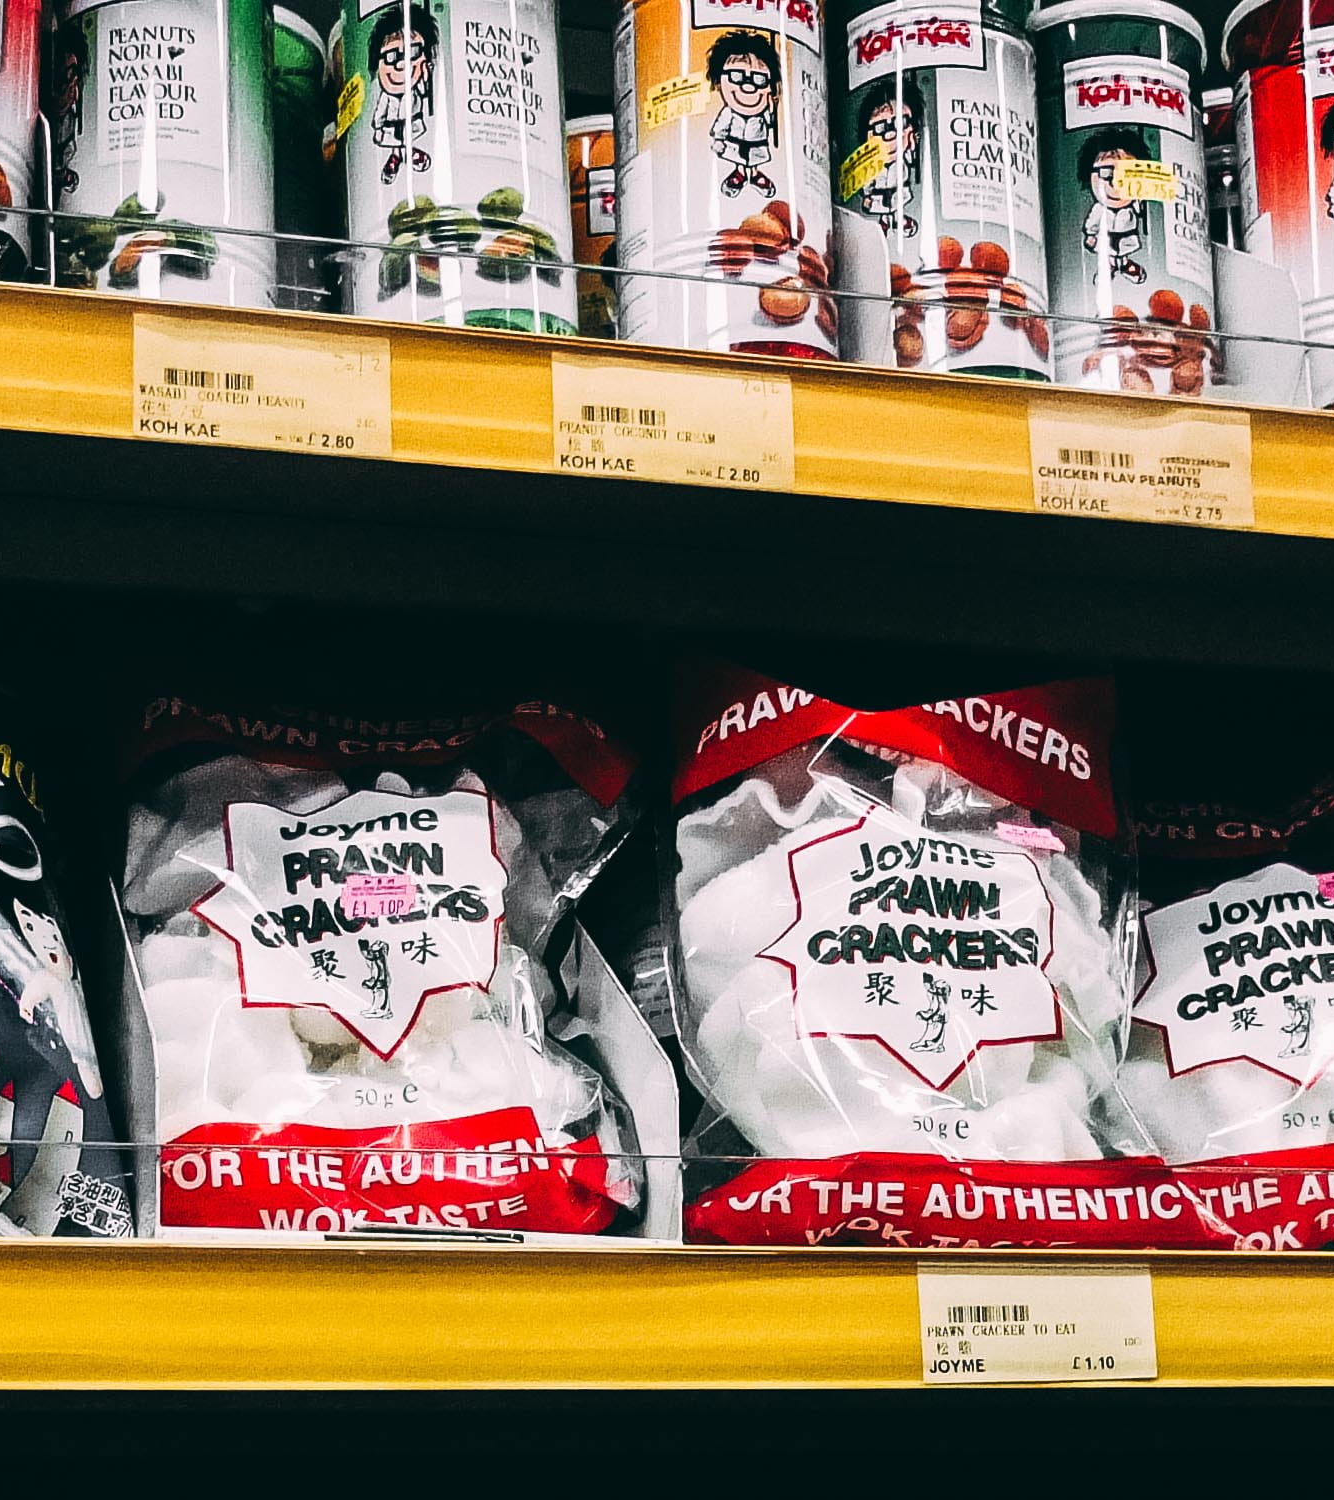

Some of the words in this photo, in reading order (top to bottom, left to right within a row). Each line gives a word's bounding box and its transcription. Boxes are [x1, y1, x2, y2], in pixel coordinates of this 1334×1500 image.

[109, 26, 195, 46] PEANUTS
[109, 45, 163, 63] NORI
[466, 39, 517, 64] NORI
[108, 64, 183, 83] WASABI
[466, 59, 534, 89] WASABI
[108, 102, 184, 122] COAED
[139, 418, 179, 436] KOH
[184, 422, 221, 438] KAE
[321, 434, 355, 450] 2.80
[560, 453, 597, 472] KOH
[602, 457, 637, 473] KAE
[729, 468, 761, 484] 2.80
[1038, 466, 1100, 482] CHICKEN
[1103, 471, 1137, 485] FLAV
[1140, 474, 1202, 489] PEANUTS
[1040, 494, 1074, 511] KOH
[1078, 498, 1111, 514] KAE
[278, 807, 440, 842] Joyme
[282, 840, 445, 896] PRAWN
[849, 836, 997, 884] Joyme
[847, 873, 1002, 922] PRAWN
[311, 947, 347, 984] 聚
[400, 931, 441, 965] 味
[806, 921, 1041, 971] CRACKERS
[863, 970, 901, 1007] 聚
[960, 983, 1000, 1018] 味
[353, 1086, 378, 1108] 50
[1281, 1111, 1305, 1130] 50
[257, 1148, 346, 1191] THE
[807, 1180, 906, 1217] THE
[920, 1181, 1183, 1223] AUTHENTIC
[1200, 1176, 1282, 1220] THE
[927, 1324, 966, 1338] PRAWN
[972, 1323, 1026, 1337] CRACKER
[1033, 1323, 1049, 1335] TO
[929, 1358, 986, 1375] JOYME
[1072, 1356, 1083, 1370] £
[1085, 1355, 1116, 1371] 1.10
